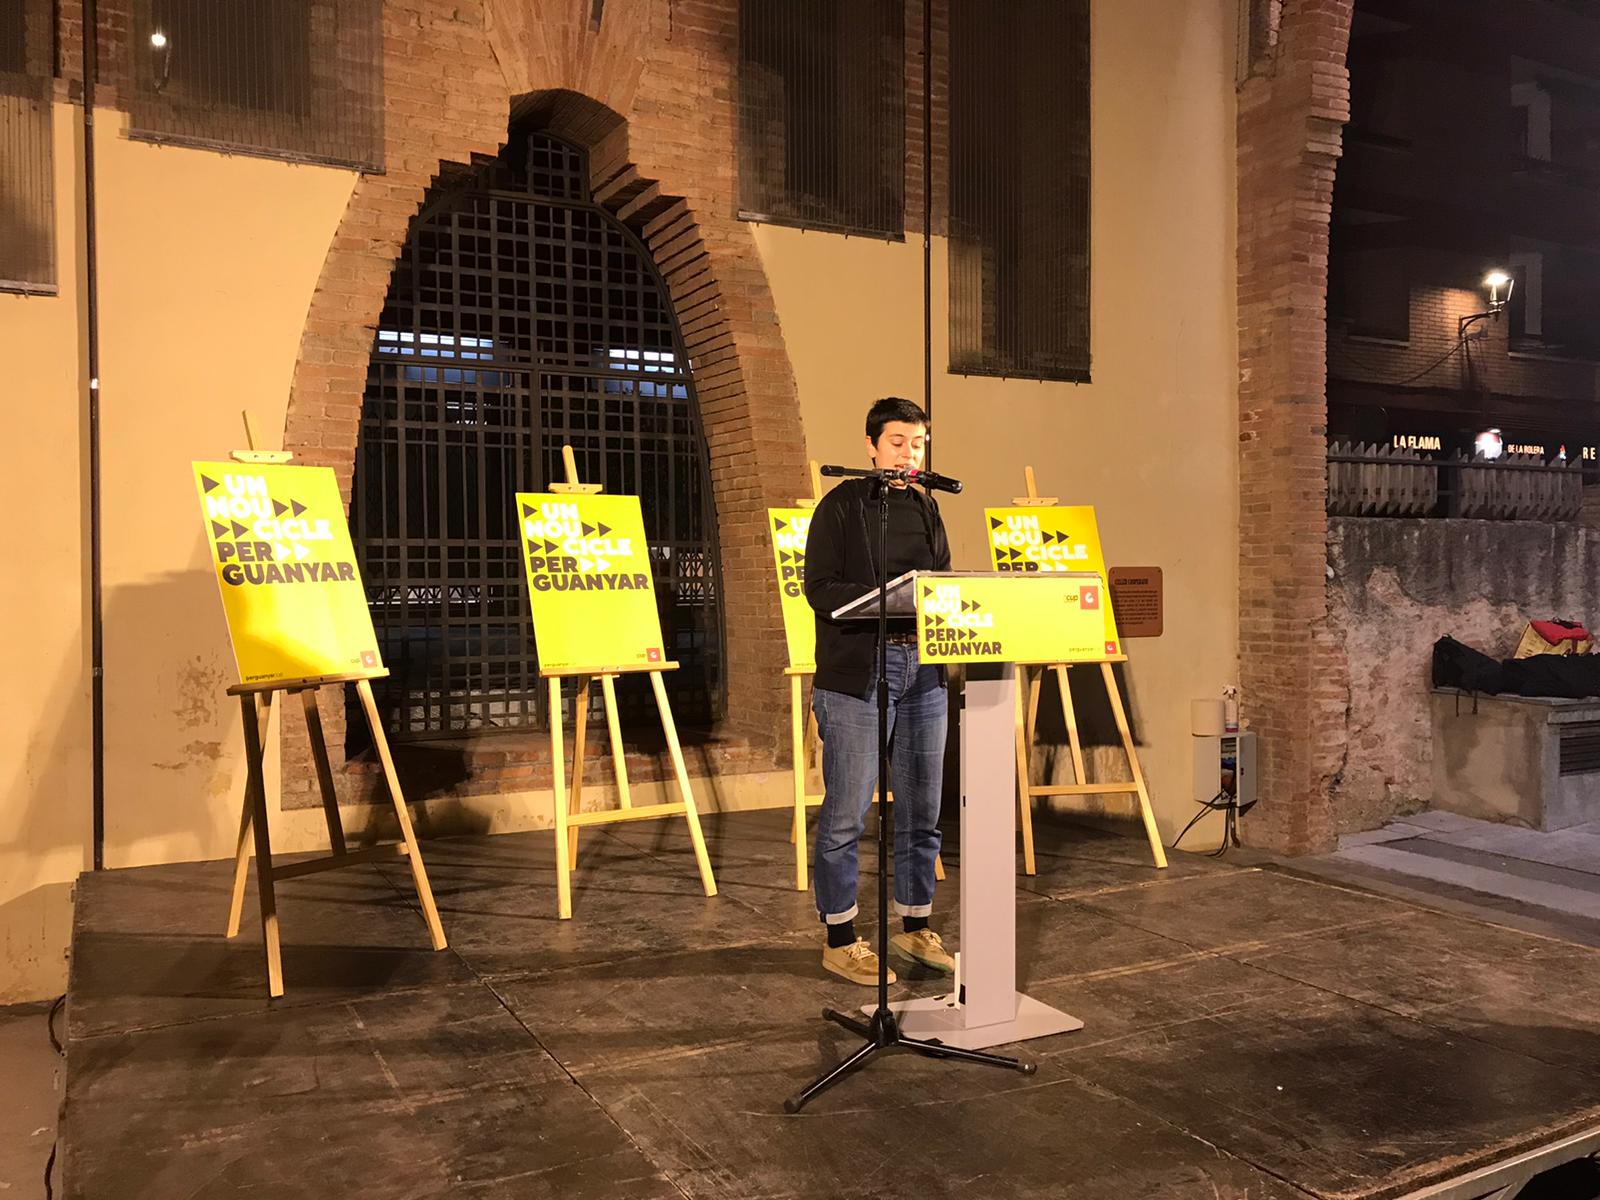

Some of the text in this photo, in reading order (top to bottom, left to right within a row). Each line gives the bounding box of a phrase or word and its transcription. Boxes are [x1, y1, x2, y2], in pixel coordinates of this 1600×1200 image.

[1393, 435, 1441, 450] LA FLAMA
[224, 474, 268, 494] UN
[206, 496, 272, 519] NOU
[541, 503, 579, 520] UN
[252, 519, 333, 541] CICLE
[525, 520, 581, 539] NOU
[790, 516, 812, 533] U
[1006, 515, 1039, 531] UN
[776, 533, 807, 550] NO
[992, 530, 1042, 547] NOU
[216, 541, 274, 562] PER
[562, 538, 633, 557] CICLE
[1025, 544, 1088, 560] CICLE
[530, 556, 579, 573] PER
[222, 562, 356, 586] GUANYAR
[781, 566, 805, 581] PE
[533, 574, 649, 592] GUANYAR
[935, 585, 960, 599] UN
[924, 600, 960, 614] NOU
[946, 613, 993, 627] CICLE
[925, 628, 957, 641] PER
[926, 642, 1002, 656] GUANYAR
